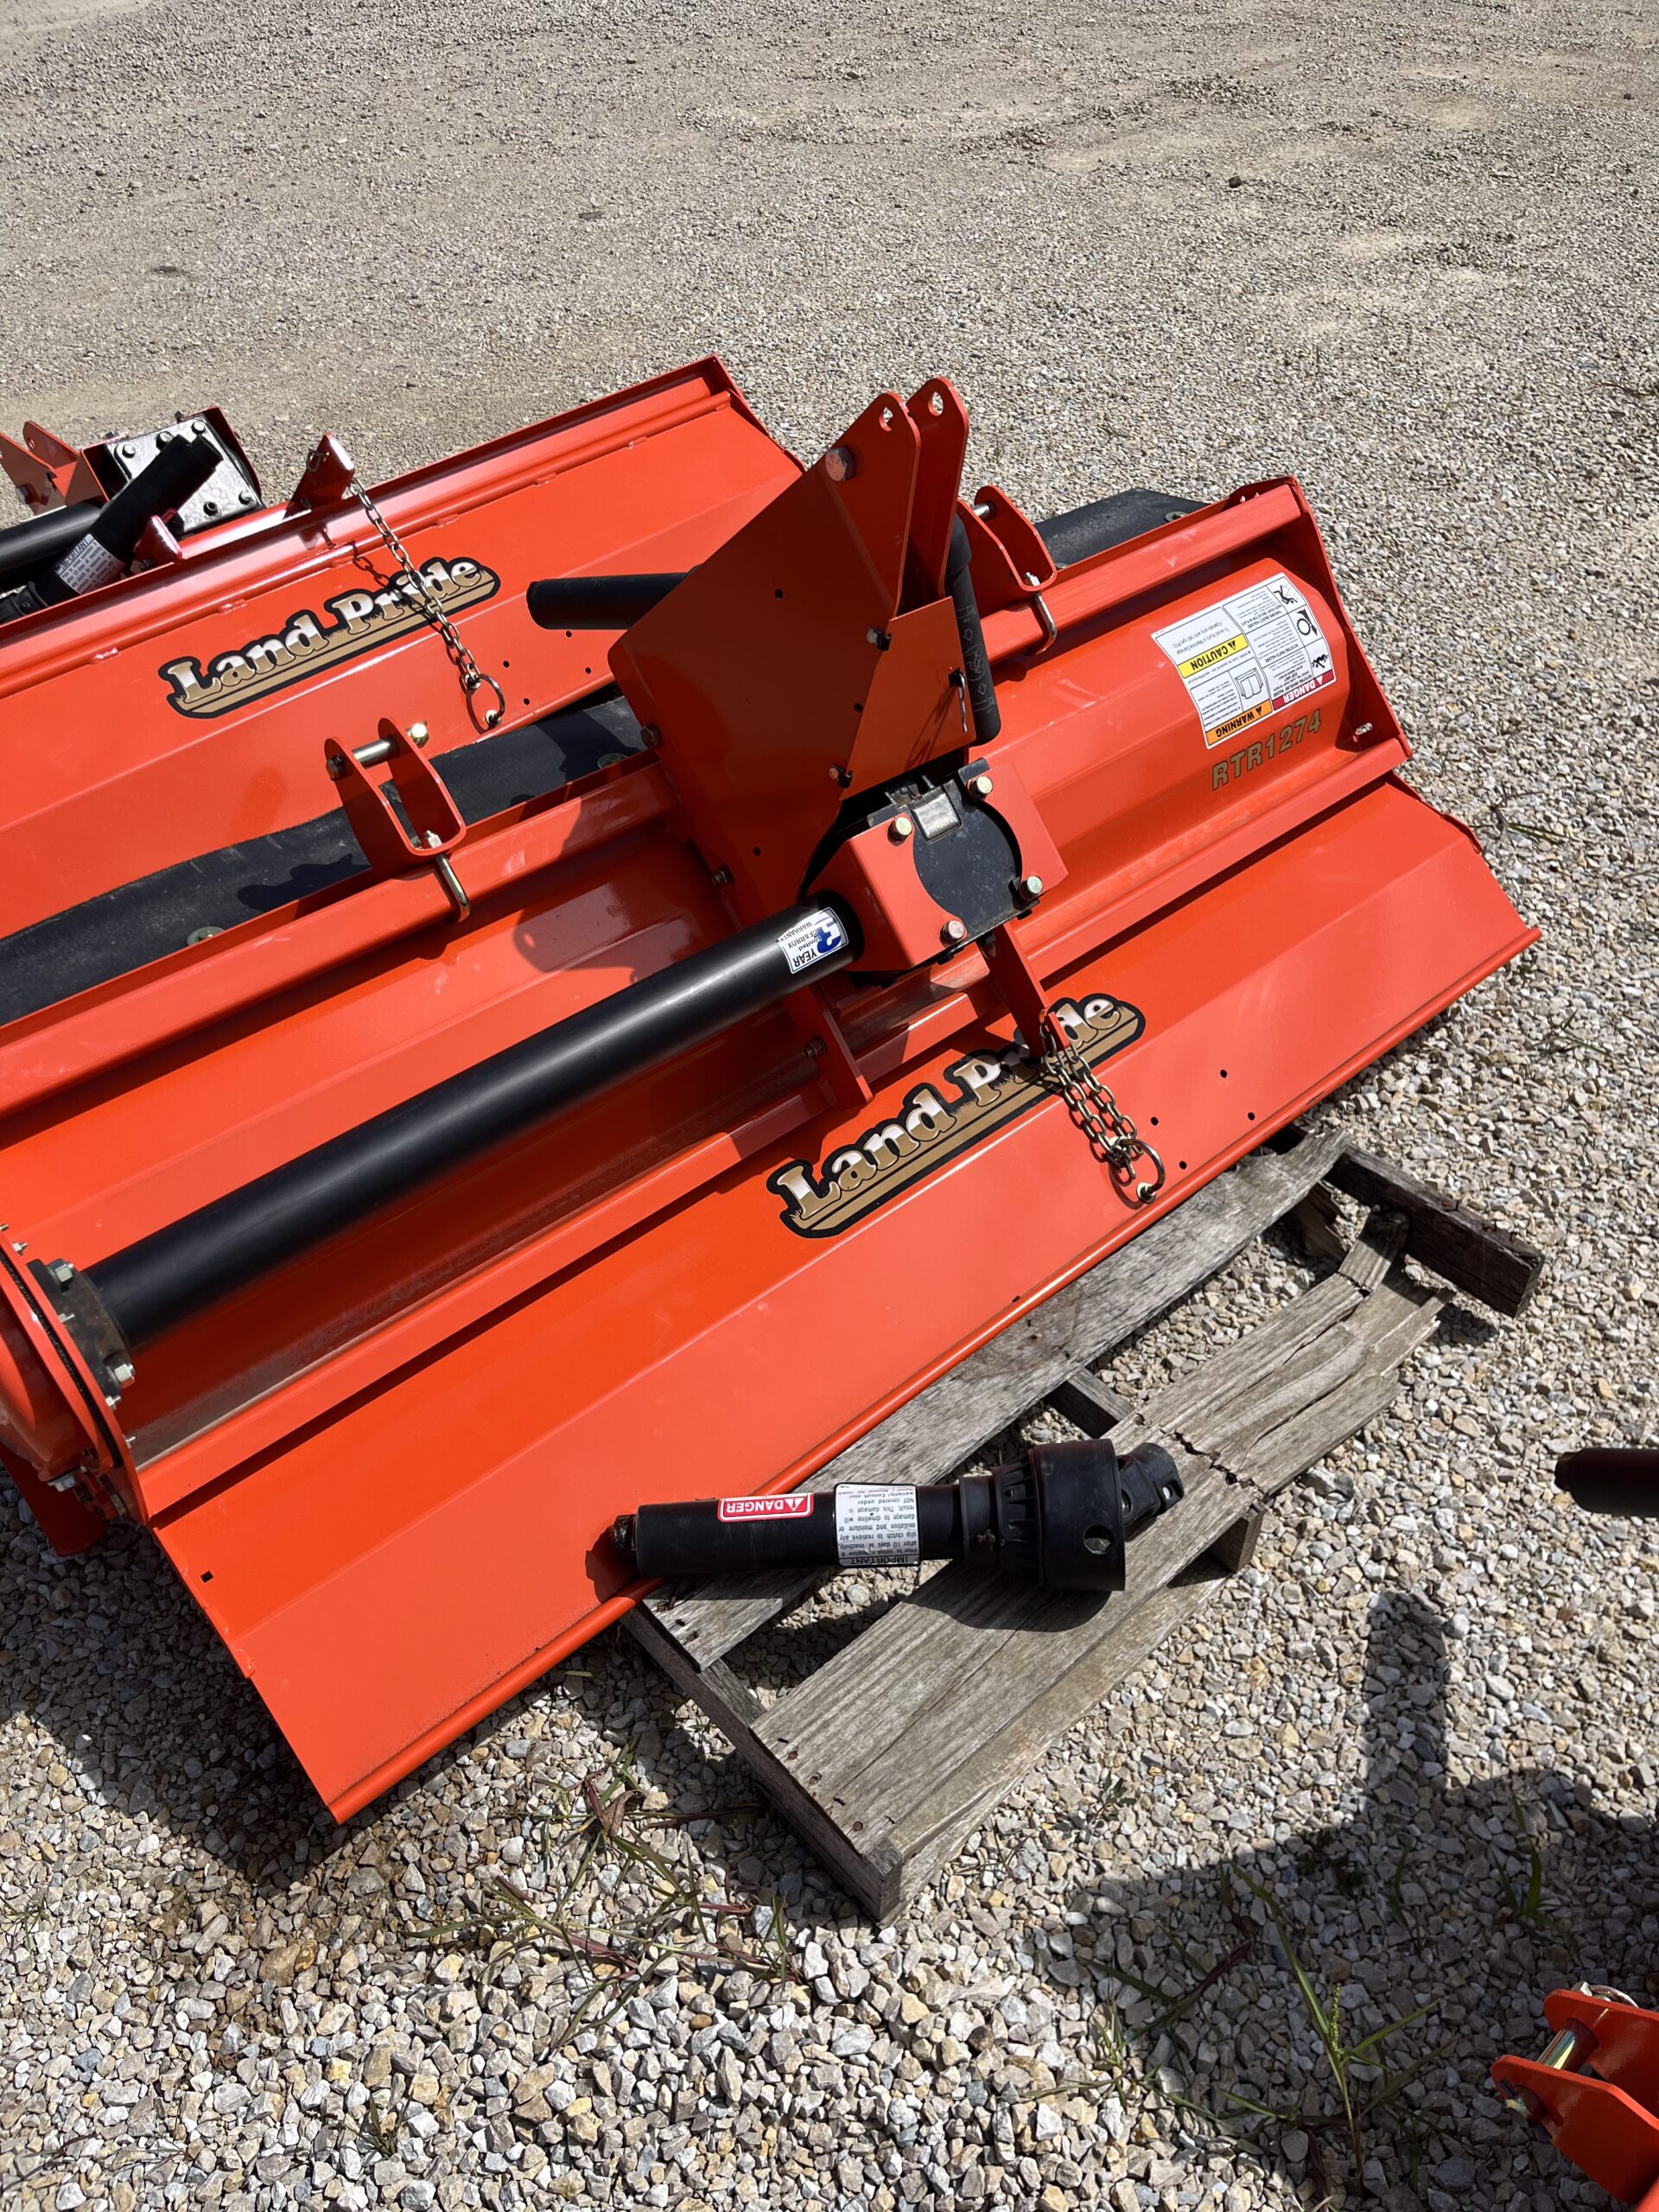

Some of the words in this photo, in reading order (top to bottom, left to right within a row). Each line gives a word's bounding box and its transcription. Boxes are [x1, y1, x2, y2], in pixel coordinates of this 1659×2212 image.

[164, 614, 330, 705] Land
[332, 557, 486, 635] Pride
[1189, 645, 1229, 671] CAUTION
[1281, 680, 1316, 702] DANGER
[1214, 710, 1255, 737] WARNING
[1211, 709, 1322, 791] RTR1274
[792, 948, 818, 968] YEAR
[777, 1089, 958, 1221] Land
[954, 995, 1122, 1107] Prde
[726, 1499, 784, 1512] DANGER
[849, 1555, 907, 1564] IMPORTANT
